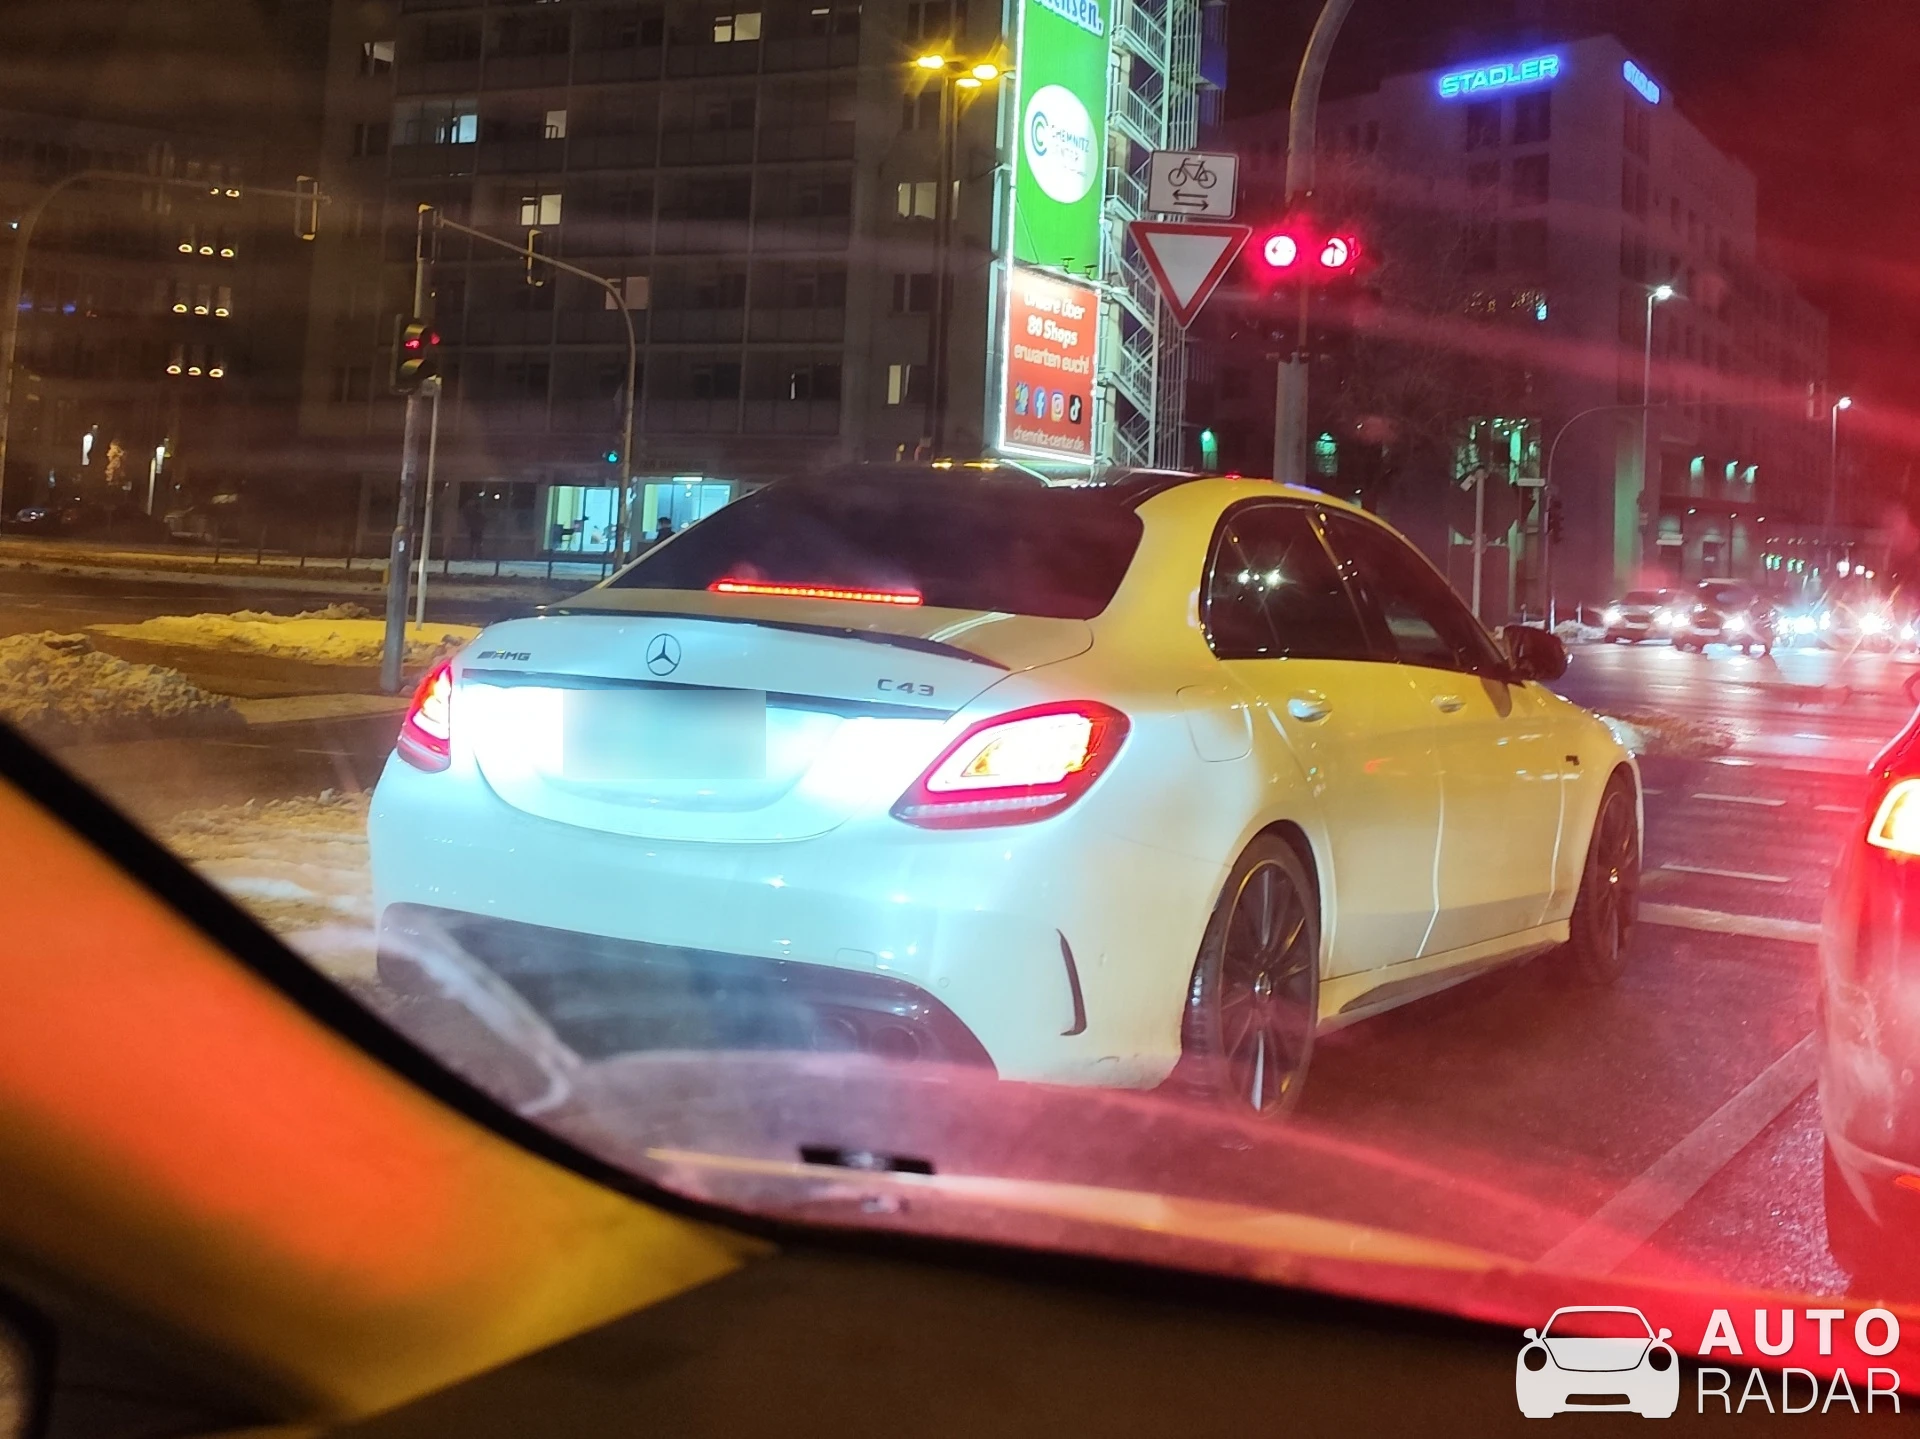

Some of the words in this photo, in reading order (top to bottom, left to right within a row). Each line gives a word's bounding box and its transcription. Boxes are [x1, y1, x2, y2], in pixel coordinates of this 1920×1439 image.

[1048, 0, 1102, 31] sen.
[1441, 56, 1558, 96] STADLER
[1027, 314, 1043, 337] 80
[1043, 319, 1078, 349] Shops
[1014, 344, 1061, 369] erwarten
[1062, 355, 1090, 375] euch!
[490, 650, 532, 661] AMG
